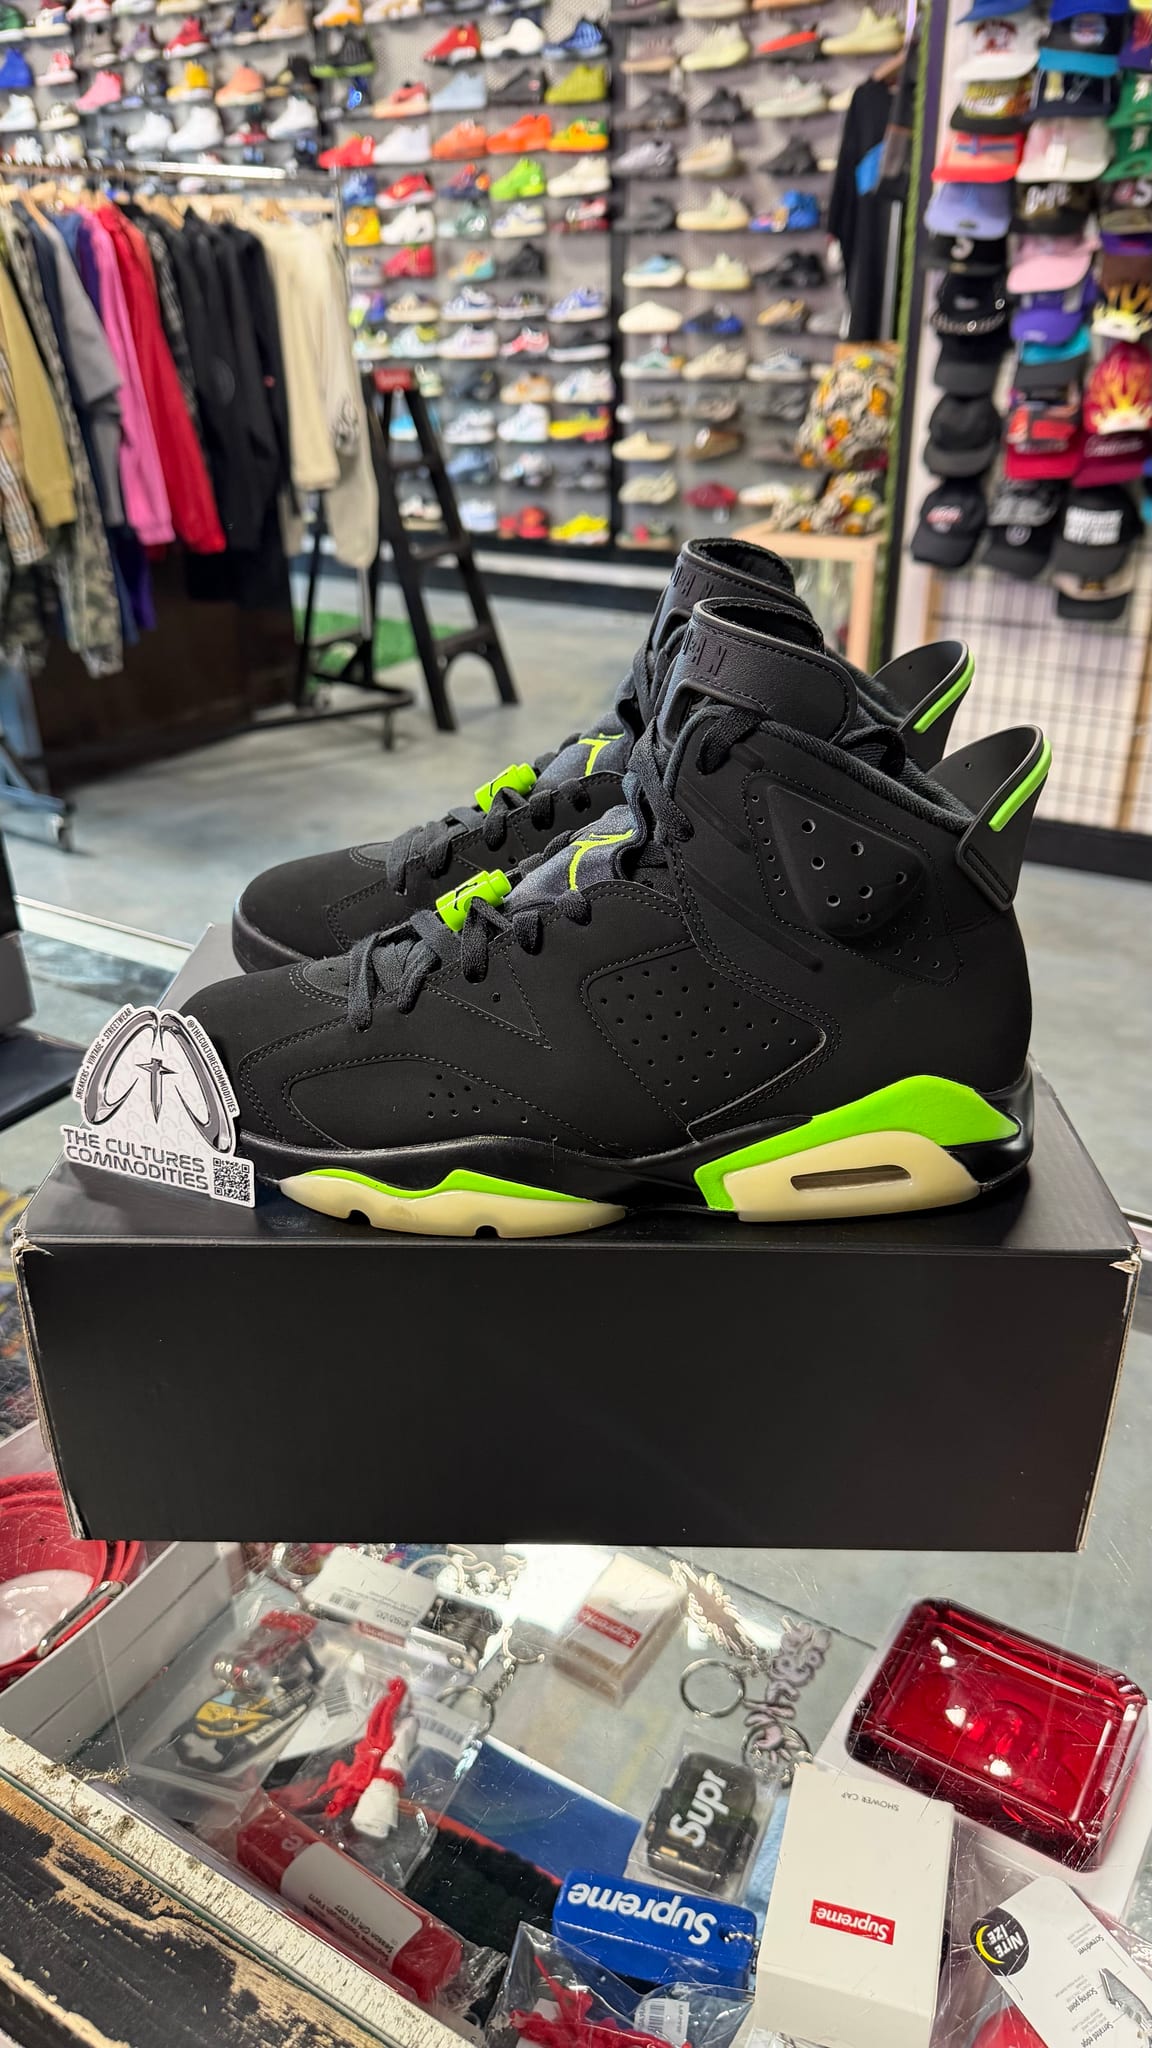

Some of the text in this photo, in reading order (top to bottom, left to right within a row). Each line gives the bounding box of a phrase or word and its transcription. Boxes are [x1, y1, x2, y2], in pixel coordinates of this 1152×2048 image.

[76, 1008, 133, 1099] SNEAKERS VINTAGE STREETWEAR
[187, 1020, 237, 1113] @THECULTURECOMMODITIES
[64, 1128, 206, 1174] THE CULTURES
[66, 1146, 209, 1191] COMMODITIES
[669, 1768, 729, 1848] Supr
[862, 1796, 899, 1811] SHOWER
[567, 1882, 717, 1945] Supreme
[816, 1906, 889, 1941] Supreme
[371, 1931, 394, 1953] Season
[987, 1924, 1008, 1945] IZE
[994, 1931, 1024, 1958] NITE
[1078, 1935, 1104, 1955] Screwdriver
[1067, 1997, 1080, 2013] point
[1077, 1987, 1098, 2004] Scoring
[1081, 2021, 1114, 2048] Serrated edge
